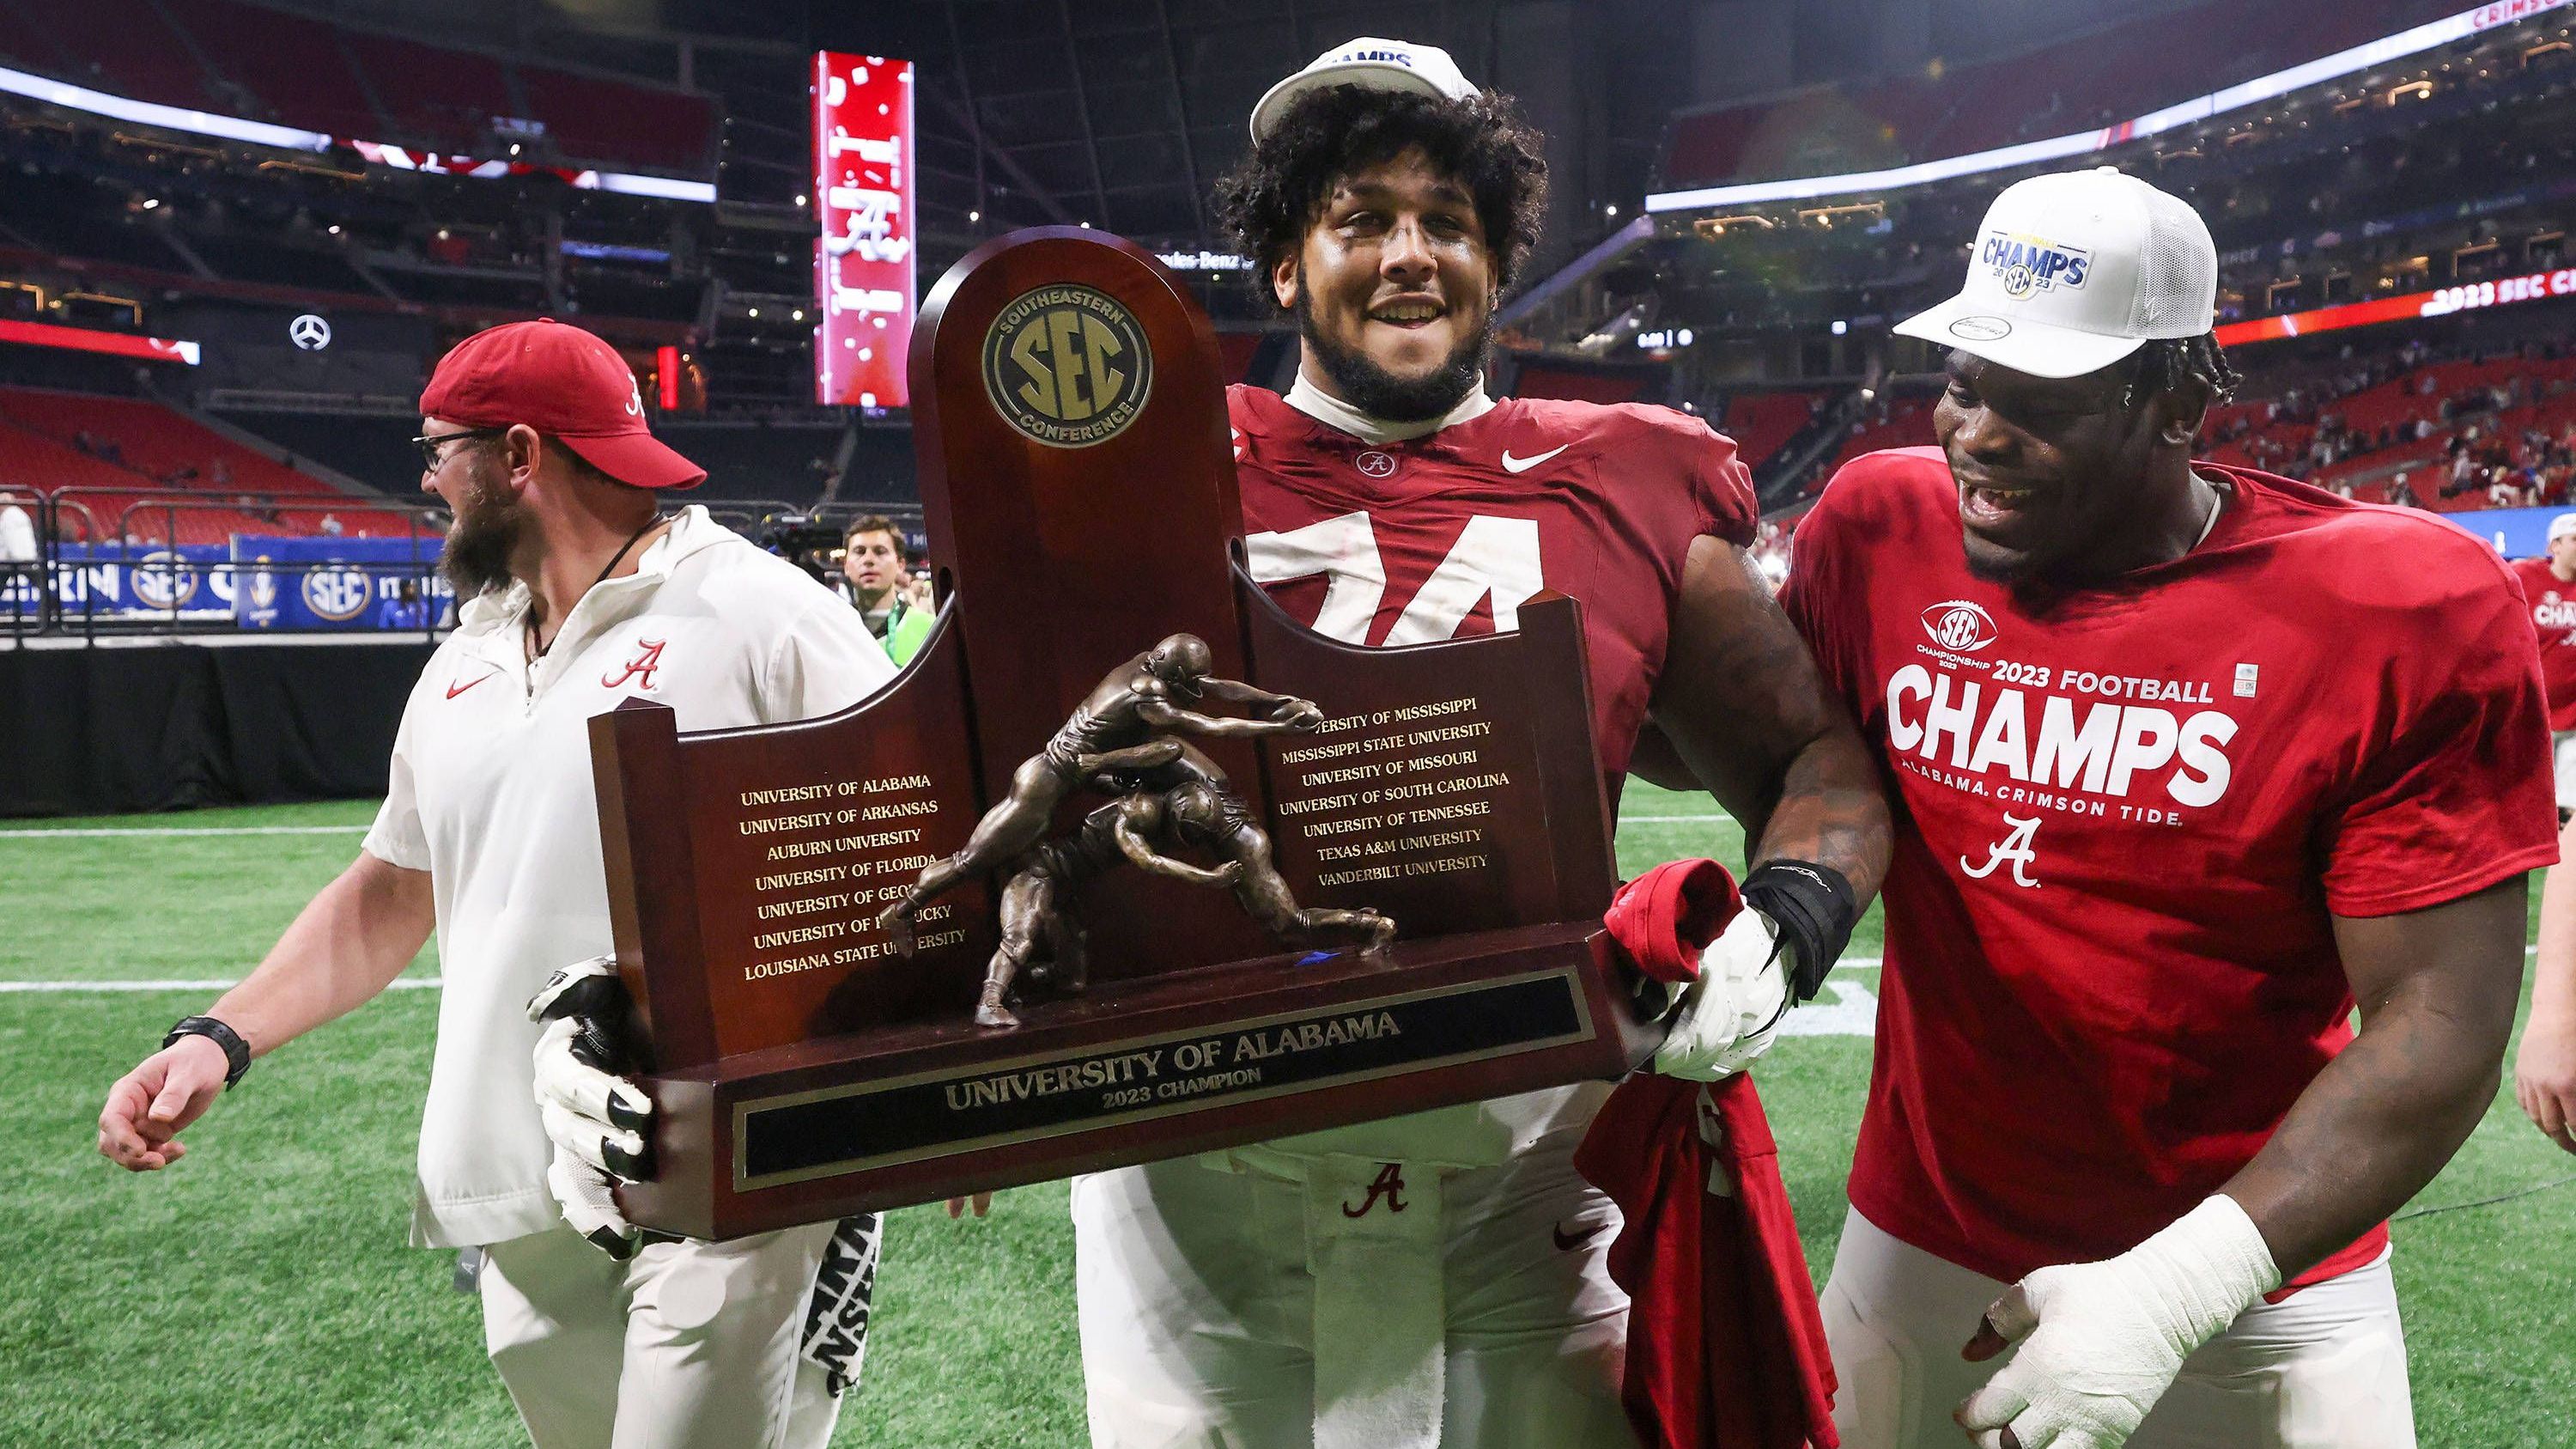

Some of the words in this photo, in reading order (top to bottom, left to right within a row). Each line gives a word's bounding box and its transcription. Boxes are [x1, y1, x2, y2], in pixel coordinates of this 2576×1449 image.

[1984, 237, 2087, 285] CHAMPS
[1000, 290, 1124, 334] SOUTHEASTERN
[1011, 310, 1125, 420] SEC
[1019, 401, 1134, 441] CONFERENCE
[1245, 510, 1544, 647] 74
[1940, 610, 1977, 648] SEC
[1917, 644, 1990, 670] CHAMPIONSHIP
[1939, 660, 1958, 670] 2023
[1992, 660, 2051, 687] 2023
[2060, 670, 2215, 703] FOOTBALL
[1373, 711, 1390, 725] OF
[1395, 697, 1477, 721] MISSISSIPPI
[1282, 741, 1360, 764] MISSISSIPPI
[1364, 735, 1405, 752] STATE
[1409, 722, 1492, 746] UNIVERSITY
[1886, 664, 2239, 807] CHAMPS
[1302, 764, 1381, 786] UNIVERSITY
[1386, 761, 1404, 775] OF
[1408, 751, 1477, 771] MISSOURI
[741, 784, 833, 807] UNIVERSITY
[838, 782, 858, 796] OF
[863, 775, 931, 793] ALABAMA
[1279, 793, 1358, 815] UNIVERSITY
[1362, 790, 1381, 804] OF
[1385, 782, 1433, 801] SOUTH
[1437, 772, 1510, 794] CAROLINA
[1996, 786, 2105, 817] CRIMSON
[739, 813, 832, 836] UNIVERSITY
[837, 810, 857, 824] OF
[862, 801, 939, 821] ARKANSAS
[1303, 815, 1382, 837] UNIVERSITY
[1388, 813, 1406, 826] OF
[1410, 801, 1491, 823] TENNESSEE
[767, 840, 831, 861] AUBURN
[835, 829, 921, 852] UNIVERSITY
[1317, 844, 1361, 861] TEXAS
[1364, 839, 1396, 855] A&M
[1400, 828, 1482, 851] UNIVERSITY
[756, 866, 847, 891] UNIVERSITY
[852, 863, 872, 877] OF
[1319, 865, 1400, 886] VANDERBILT
[1406, 854, 1488, 876] UNIVERSITY
[757, 893, 849, 920] UNIVERSITY
[854, 890, 874, 904] OF
[754, 922, 846, 949] UNIVERSITY
[851, 919, 871, 933] OF
[744, 953, 830, 981] LOUISIANA
[834, 944, 879, 964] STATE
[945, 1050, 1163, 1111] UNIVERSITY
[1174, 1040, 1221, 1072] OF
[1233, 1011, 1400, 1062] ALABAMA
[1103, 1087, 1152, 1110] 2023
[1157, 1067, 1261, 1099] CHAMPION
